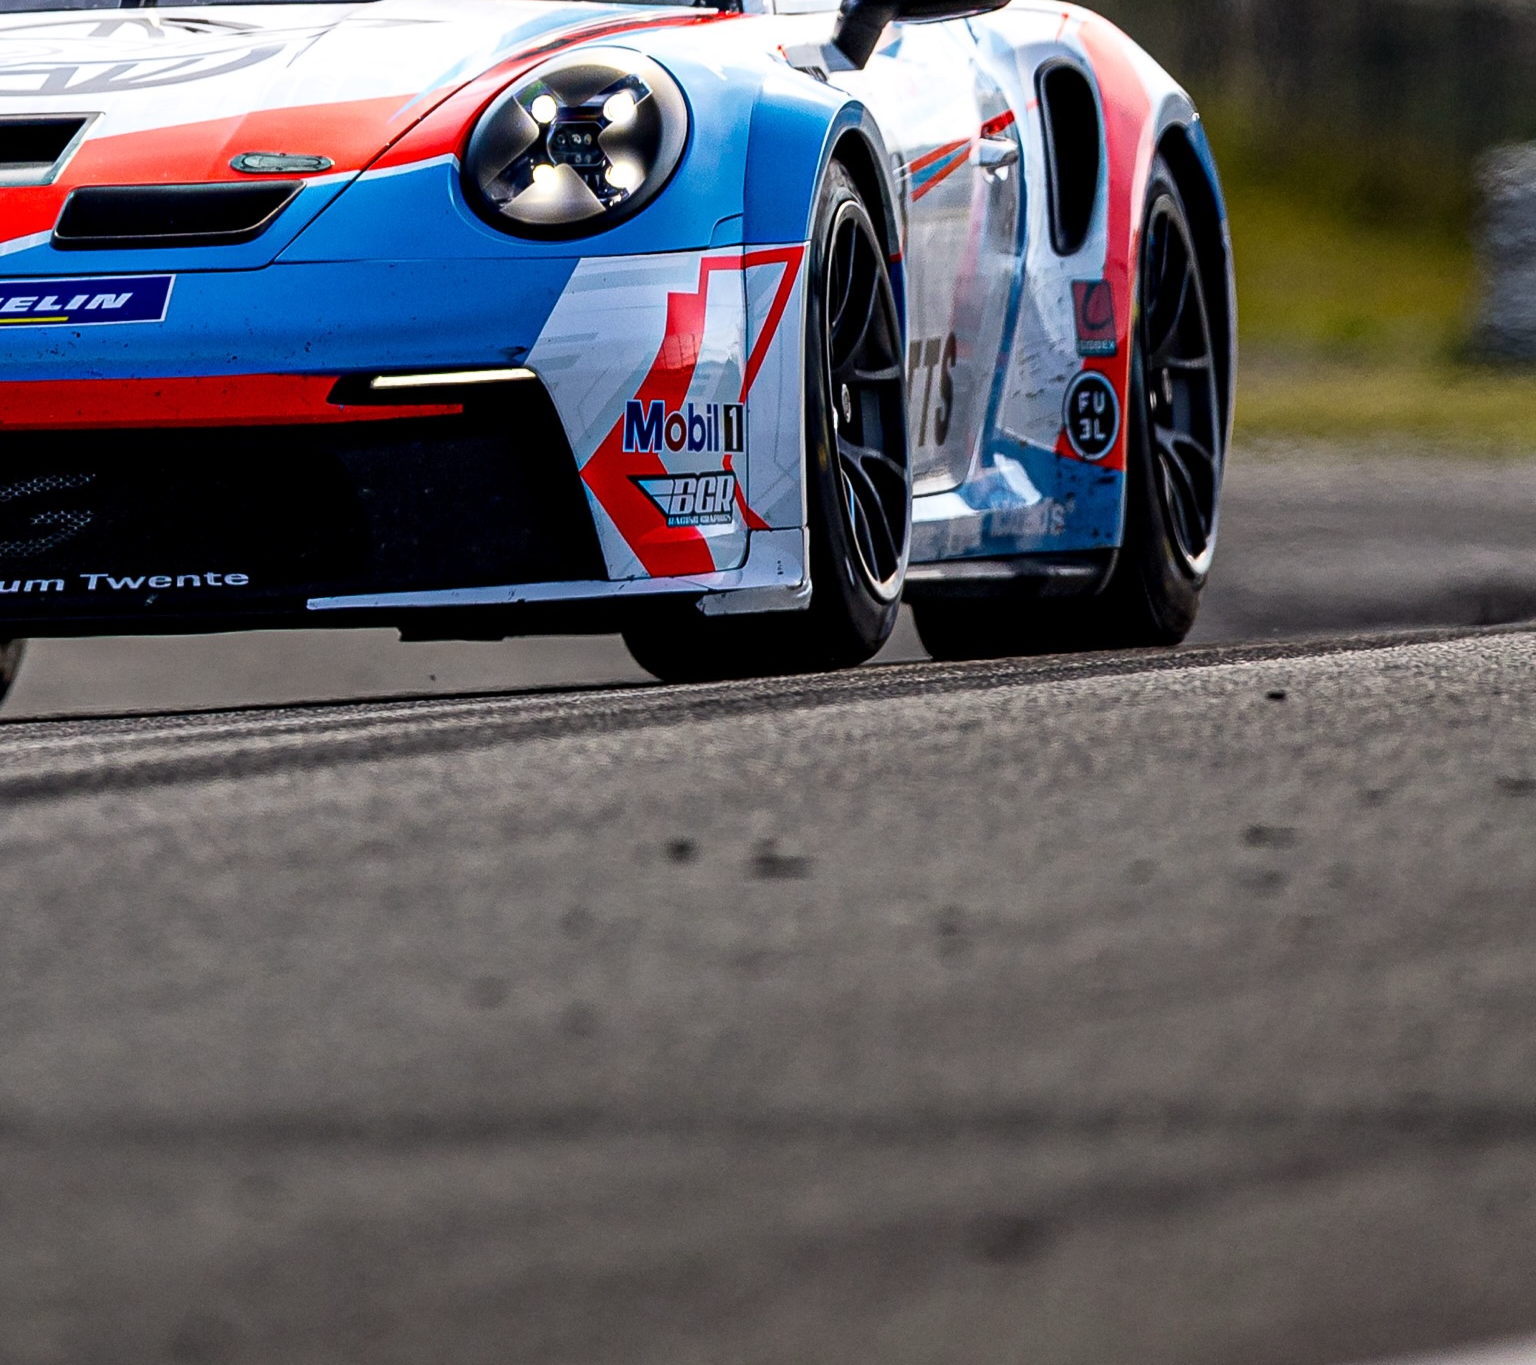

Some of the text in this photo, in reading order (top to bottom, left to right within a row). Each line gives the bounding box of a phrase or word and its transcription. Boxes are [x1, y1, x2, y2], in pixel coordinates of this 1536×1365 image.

[1077, 391, 1106, 414] FU
[623, 400, 740, 453] Mobil 1
[669, 475, 735, 515] BGR
[80, 571, 249, 591] Twente
